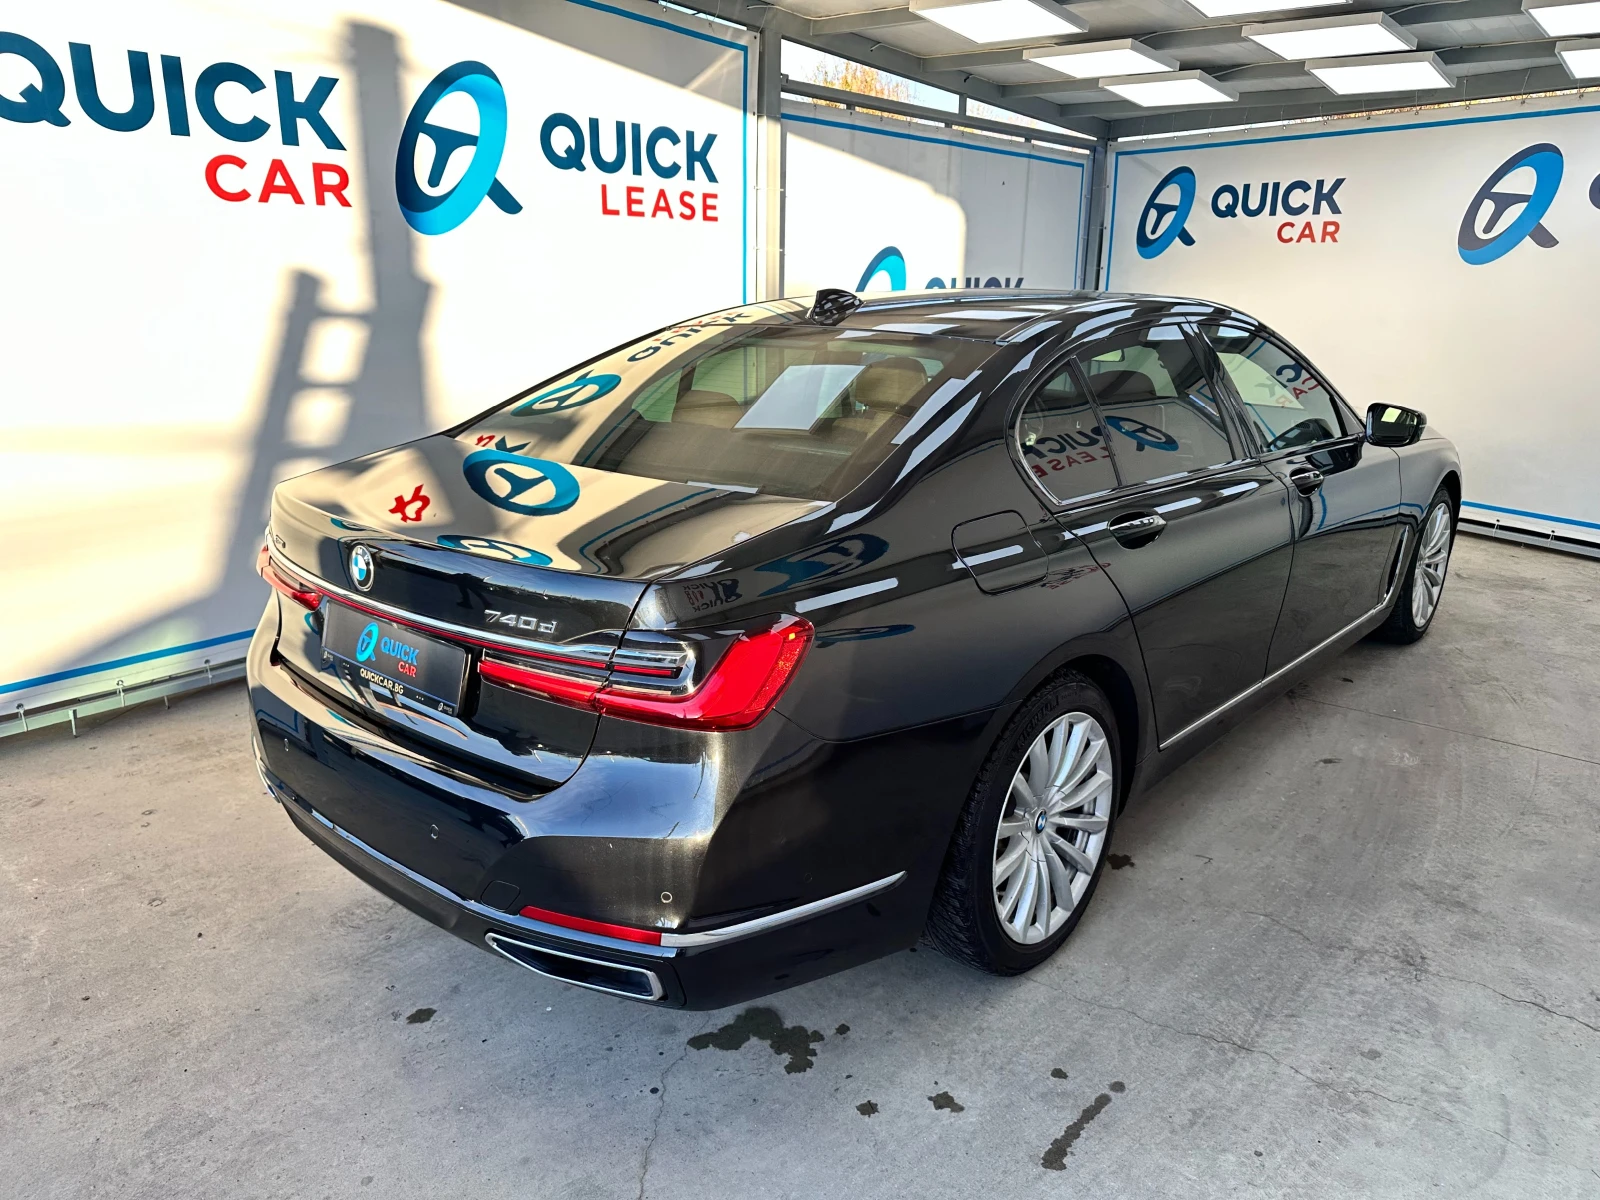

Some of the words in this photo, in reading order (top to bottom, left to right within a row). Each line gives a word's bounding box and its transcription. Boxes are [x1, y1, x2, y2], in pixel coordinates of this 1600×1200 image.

[0, 31, 347, 151] QUICK
[540, 112, 719, 184] QUICK
[205, 154, 352, 207] CAR
[601, 184, 719, 222] LEASE
[1211, 178, 1347, 218] QUICK
[1277, 221, 1340, 243] CAR
[483, 609, 558, 634] 740d
[380, 636, 420, 665] QUICK
[360, 667, 404, 695] QUICKCAR.BG
[398, 661, 417, 678] CAR
